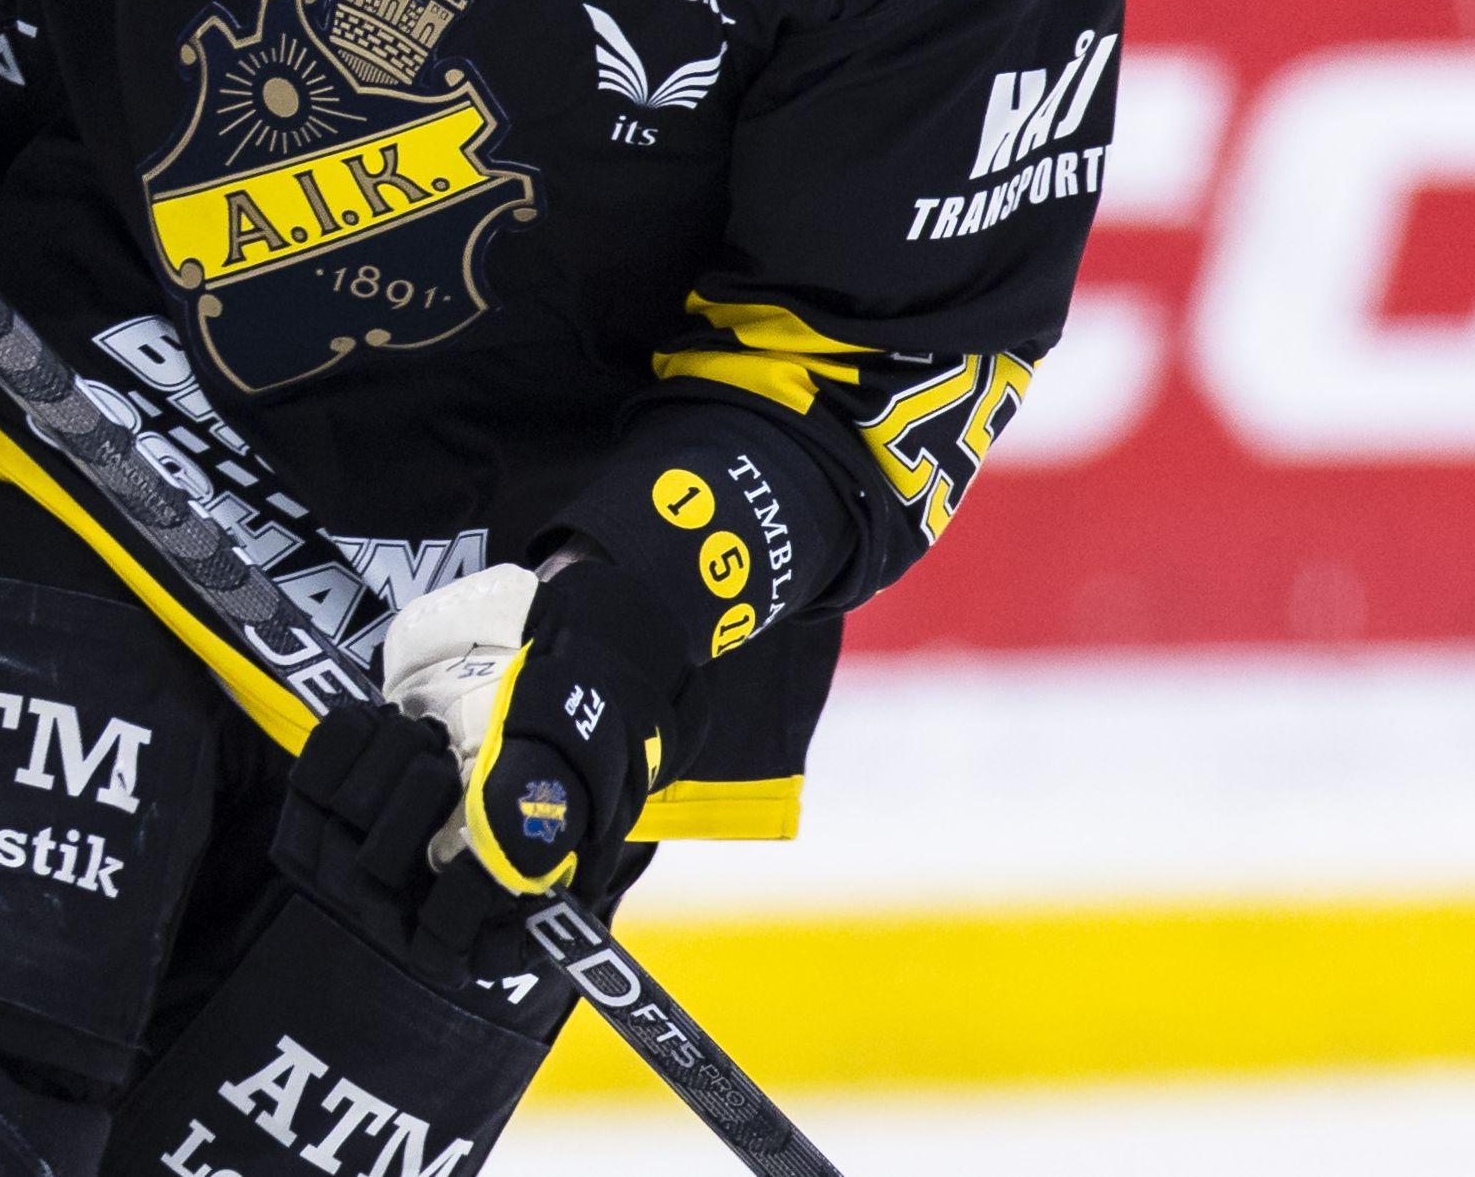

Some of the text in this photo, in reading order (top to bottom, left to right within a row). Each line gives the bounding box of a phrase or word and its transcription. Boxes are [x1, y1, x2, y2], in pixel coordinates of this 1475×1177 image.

[222, 143, 451, 267] A.I.K.
[906, 144, 1112, 241] TRANSPORT
[728, 454, 794, 639] TIMBLA
[218, 1034, 474, 1177] ATM
